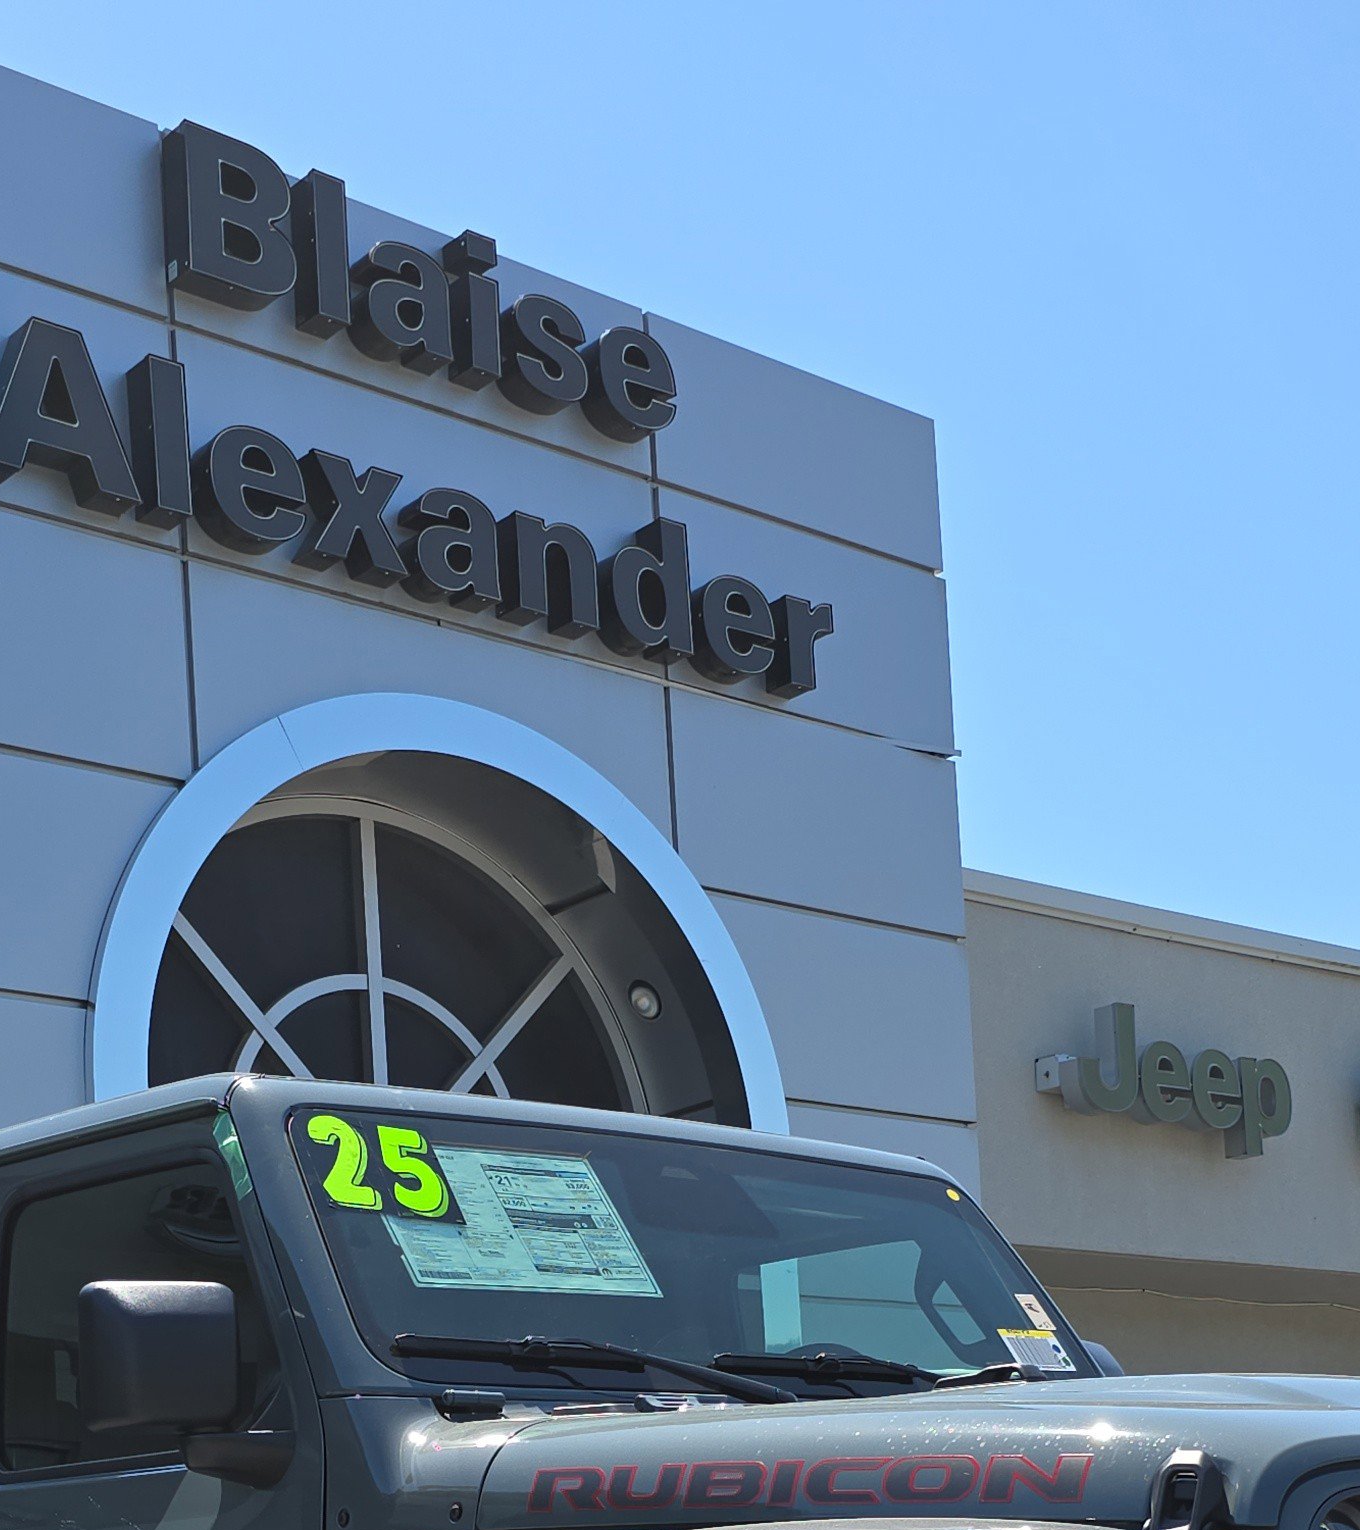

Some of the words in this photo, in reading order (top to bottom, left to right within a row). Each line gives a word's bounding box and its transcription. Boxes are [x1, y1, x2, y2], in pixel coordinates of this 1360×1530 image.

[162, 119, 677, 444] Blaise
[1059, 1002, 1292, 1159] Jeep
[307, 1115, 449, 1218] 25
[527, 1453, 1093, 1513] RUBICON
